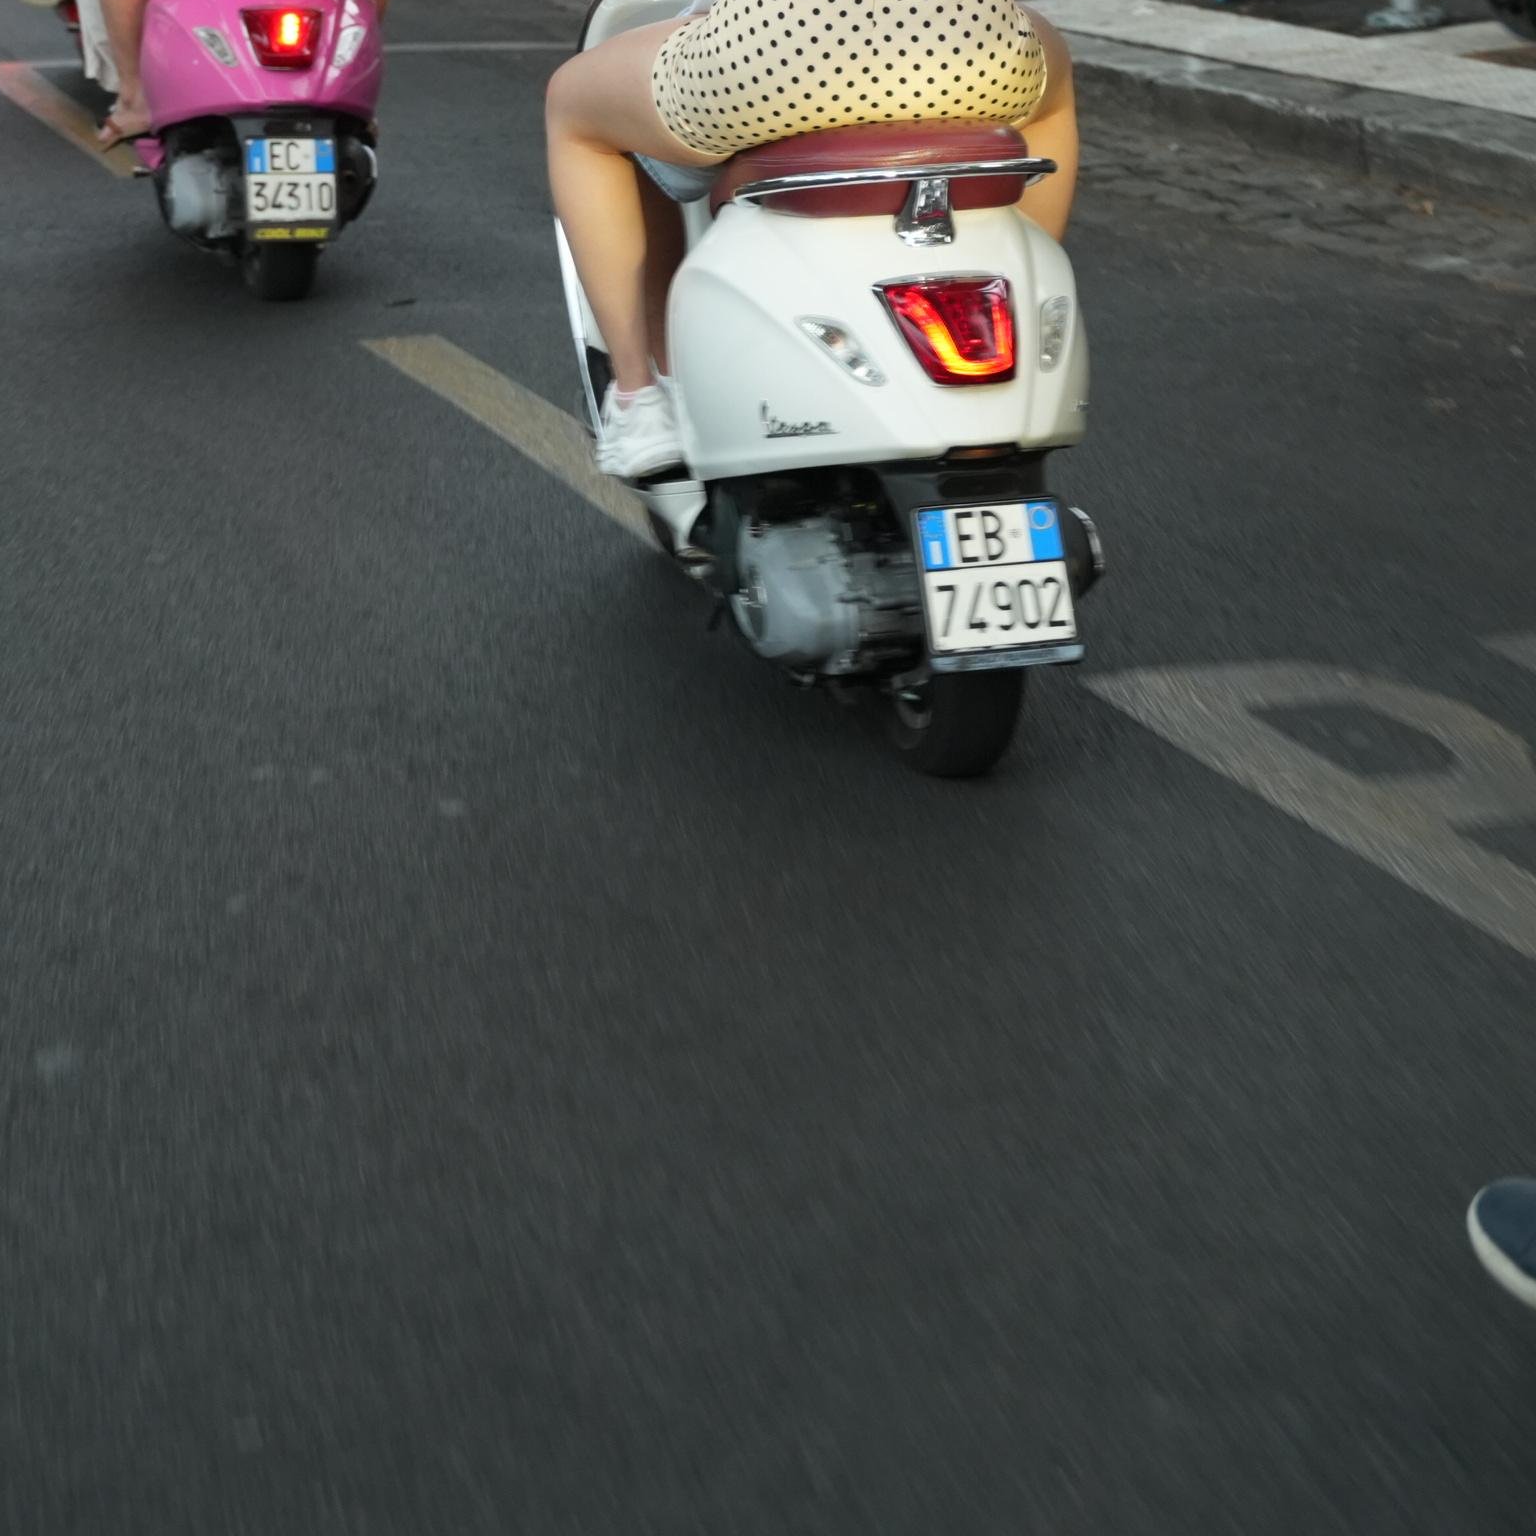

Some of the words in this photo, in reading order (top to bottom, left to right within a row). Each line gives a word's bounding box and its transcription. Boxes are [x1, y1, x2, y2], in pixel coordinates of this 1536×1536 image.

[269, 141, 301, 171] EC
[253, 181, 333, 212] 34310
[759, 398, 840, 439] Vespa
[953, 510, 1005, 564] EB
[936, 576, 1068, 637] 74902
